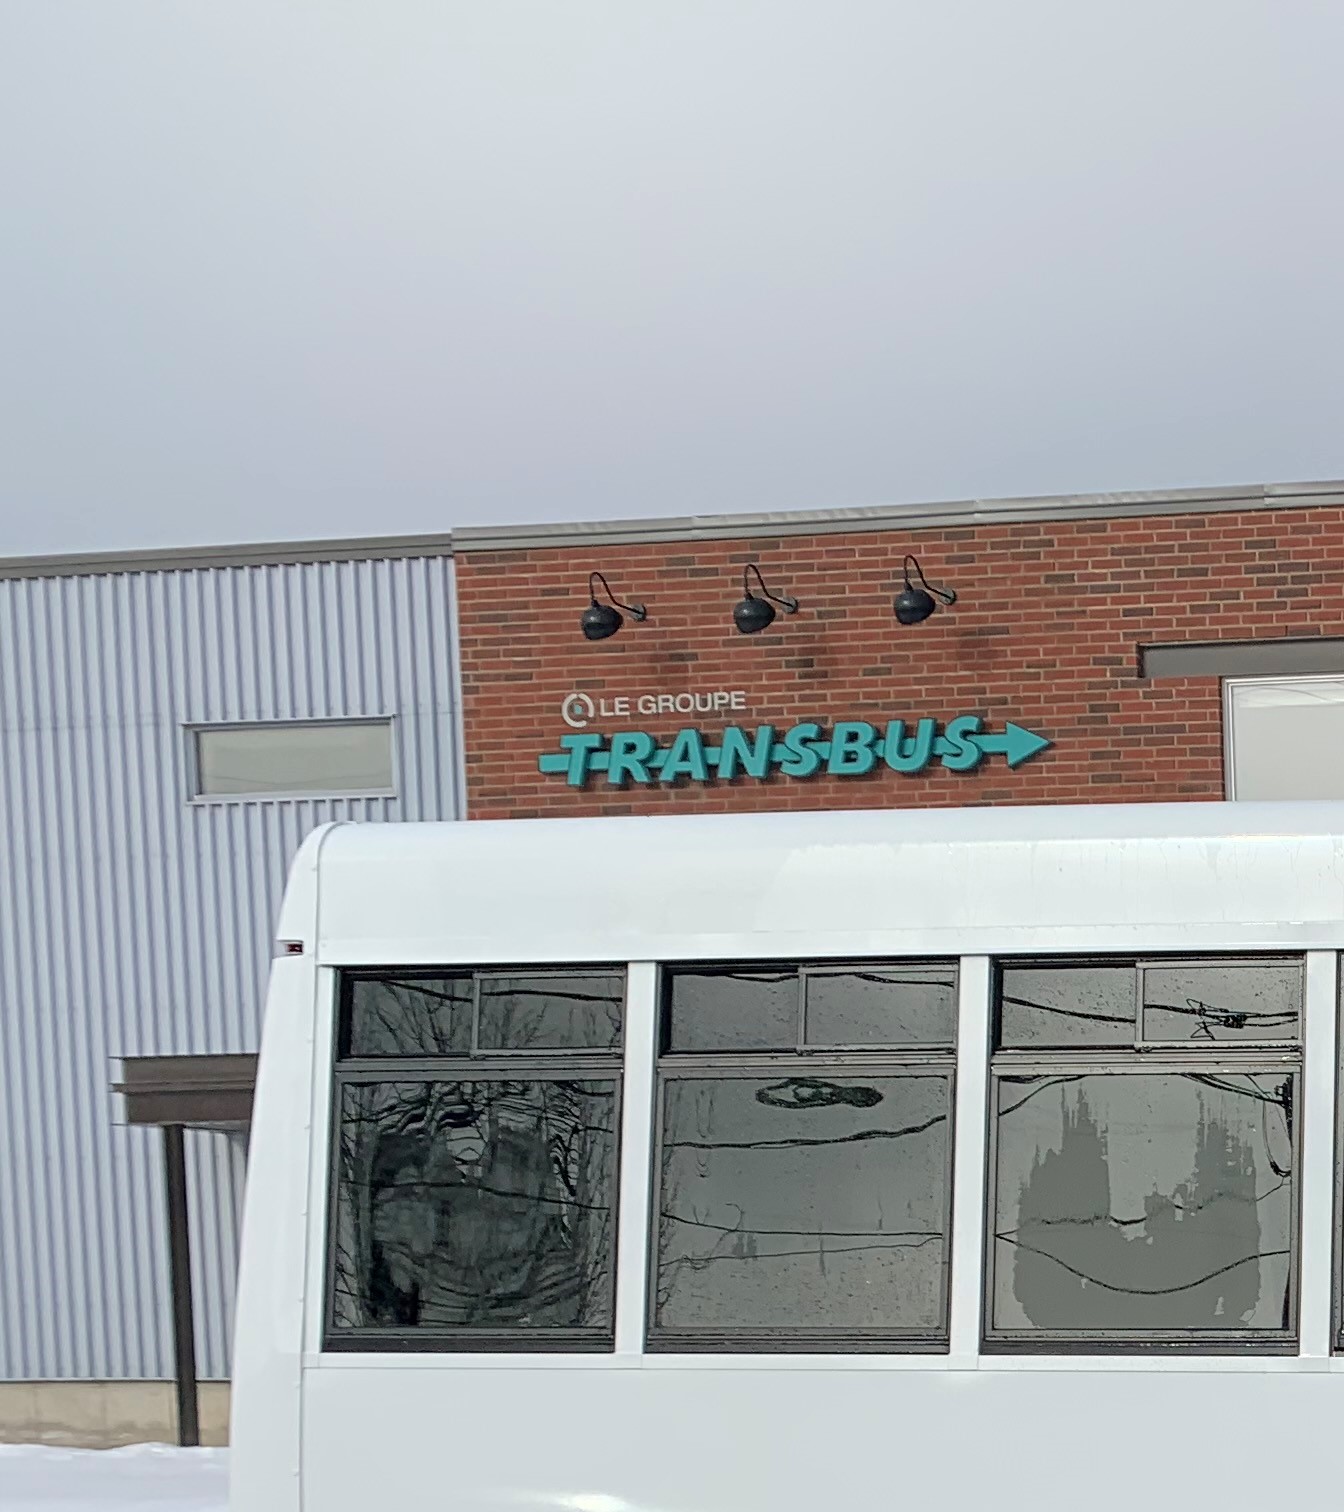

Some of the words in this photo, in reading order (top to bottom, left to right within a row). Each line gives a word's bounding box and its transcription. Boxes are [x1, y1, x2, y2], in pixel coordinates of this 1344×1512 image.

[599, 696, 631, 717] LE
[637, 690, 747, 715] GROUPE
[559, 715, 984, 787] TRANSBUS
